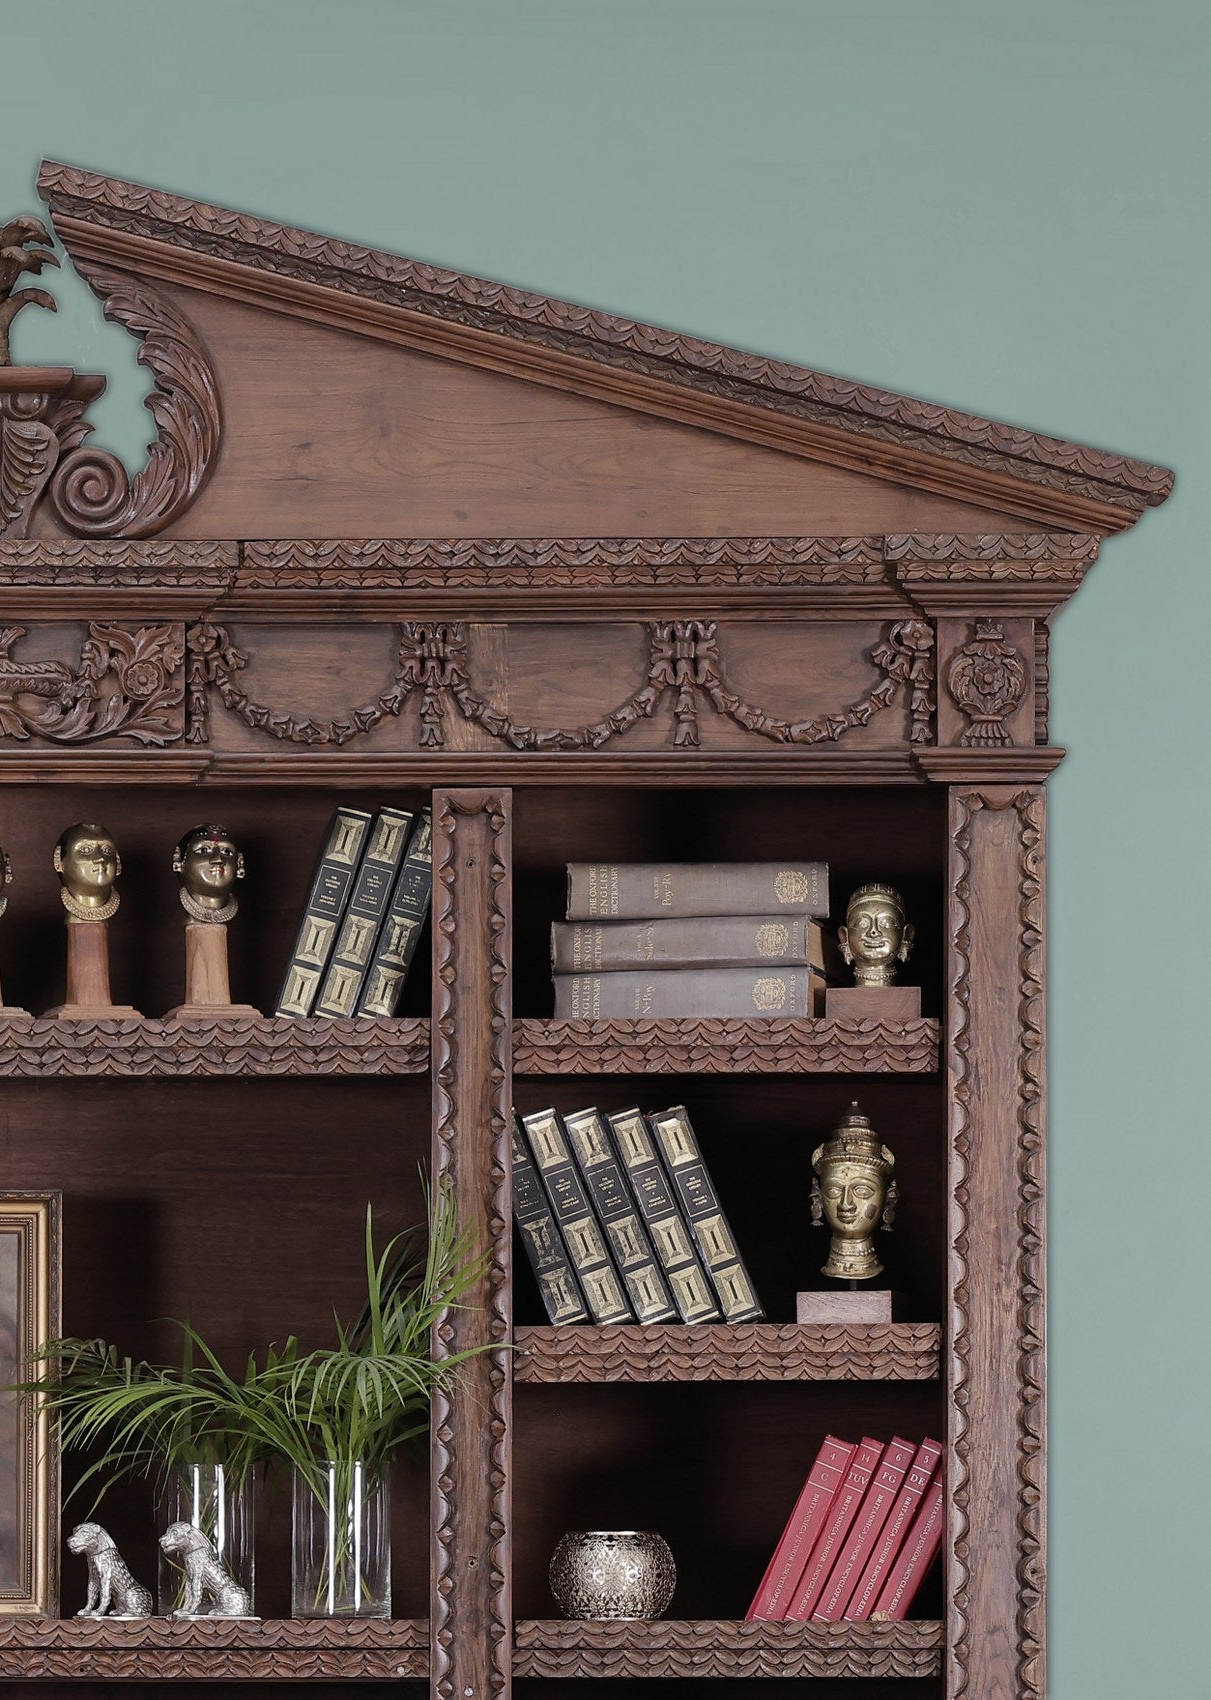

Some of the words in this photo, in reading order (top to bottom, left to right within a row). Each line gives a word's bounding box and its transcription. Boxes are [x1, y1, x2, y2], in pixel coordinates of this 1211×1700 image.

[861, 1453, 870, 1462] 14
[895, 1453, 902, 1462] 6
[923, 1455, 930, 1464] 5
[820, 1472, 828, 1482] C
[848, 1472, 868, 1485] TUV
[882, 1471, 897, 1484] FG
[910, 1473, 926, 1486] DE
[800, 1493, 820, 1534] BRITANNICA
[831, 1495, 852, 1536] BRITANNICA
[862, 1494, 884, 1534] BRITANNICA
[890, 1496, 912, 1537] BRITANNICA
[788, 1535, 802, 1562] JUNIOR
[821, 1536, 834, 1562] JUNIOR
[850, 1534, 864, 1561] JUNIOR
[878, 1537, 893, 1564] JUNIOR
[912, 1535, 926, 1562] JUNIOR
